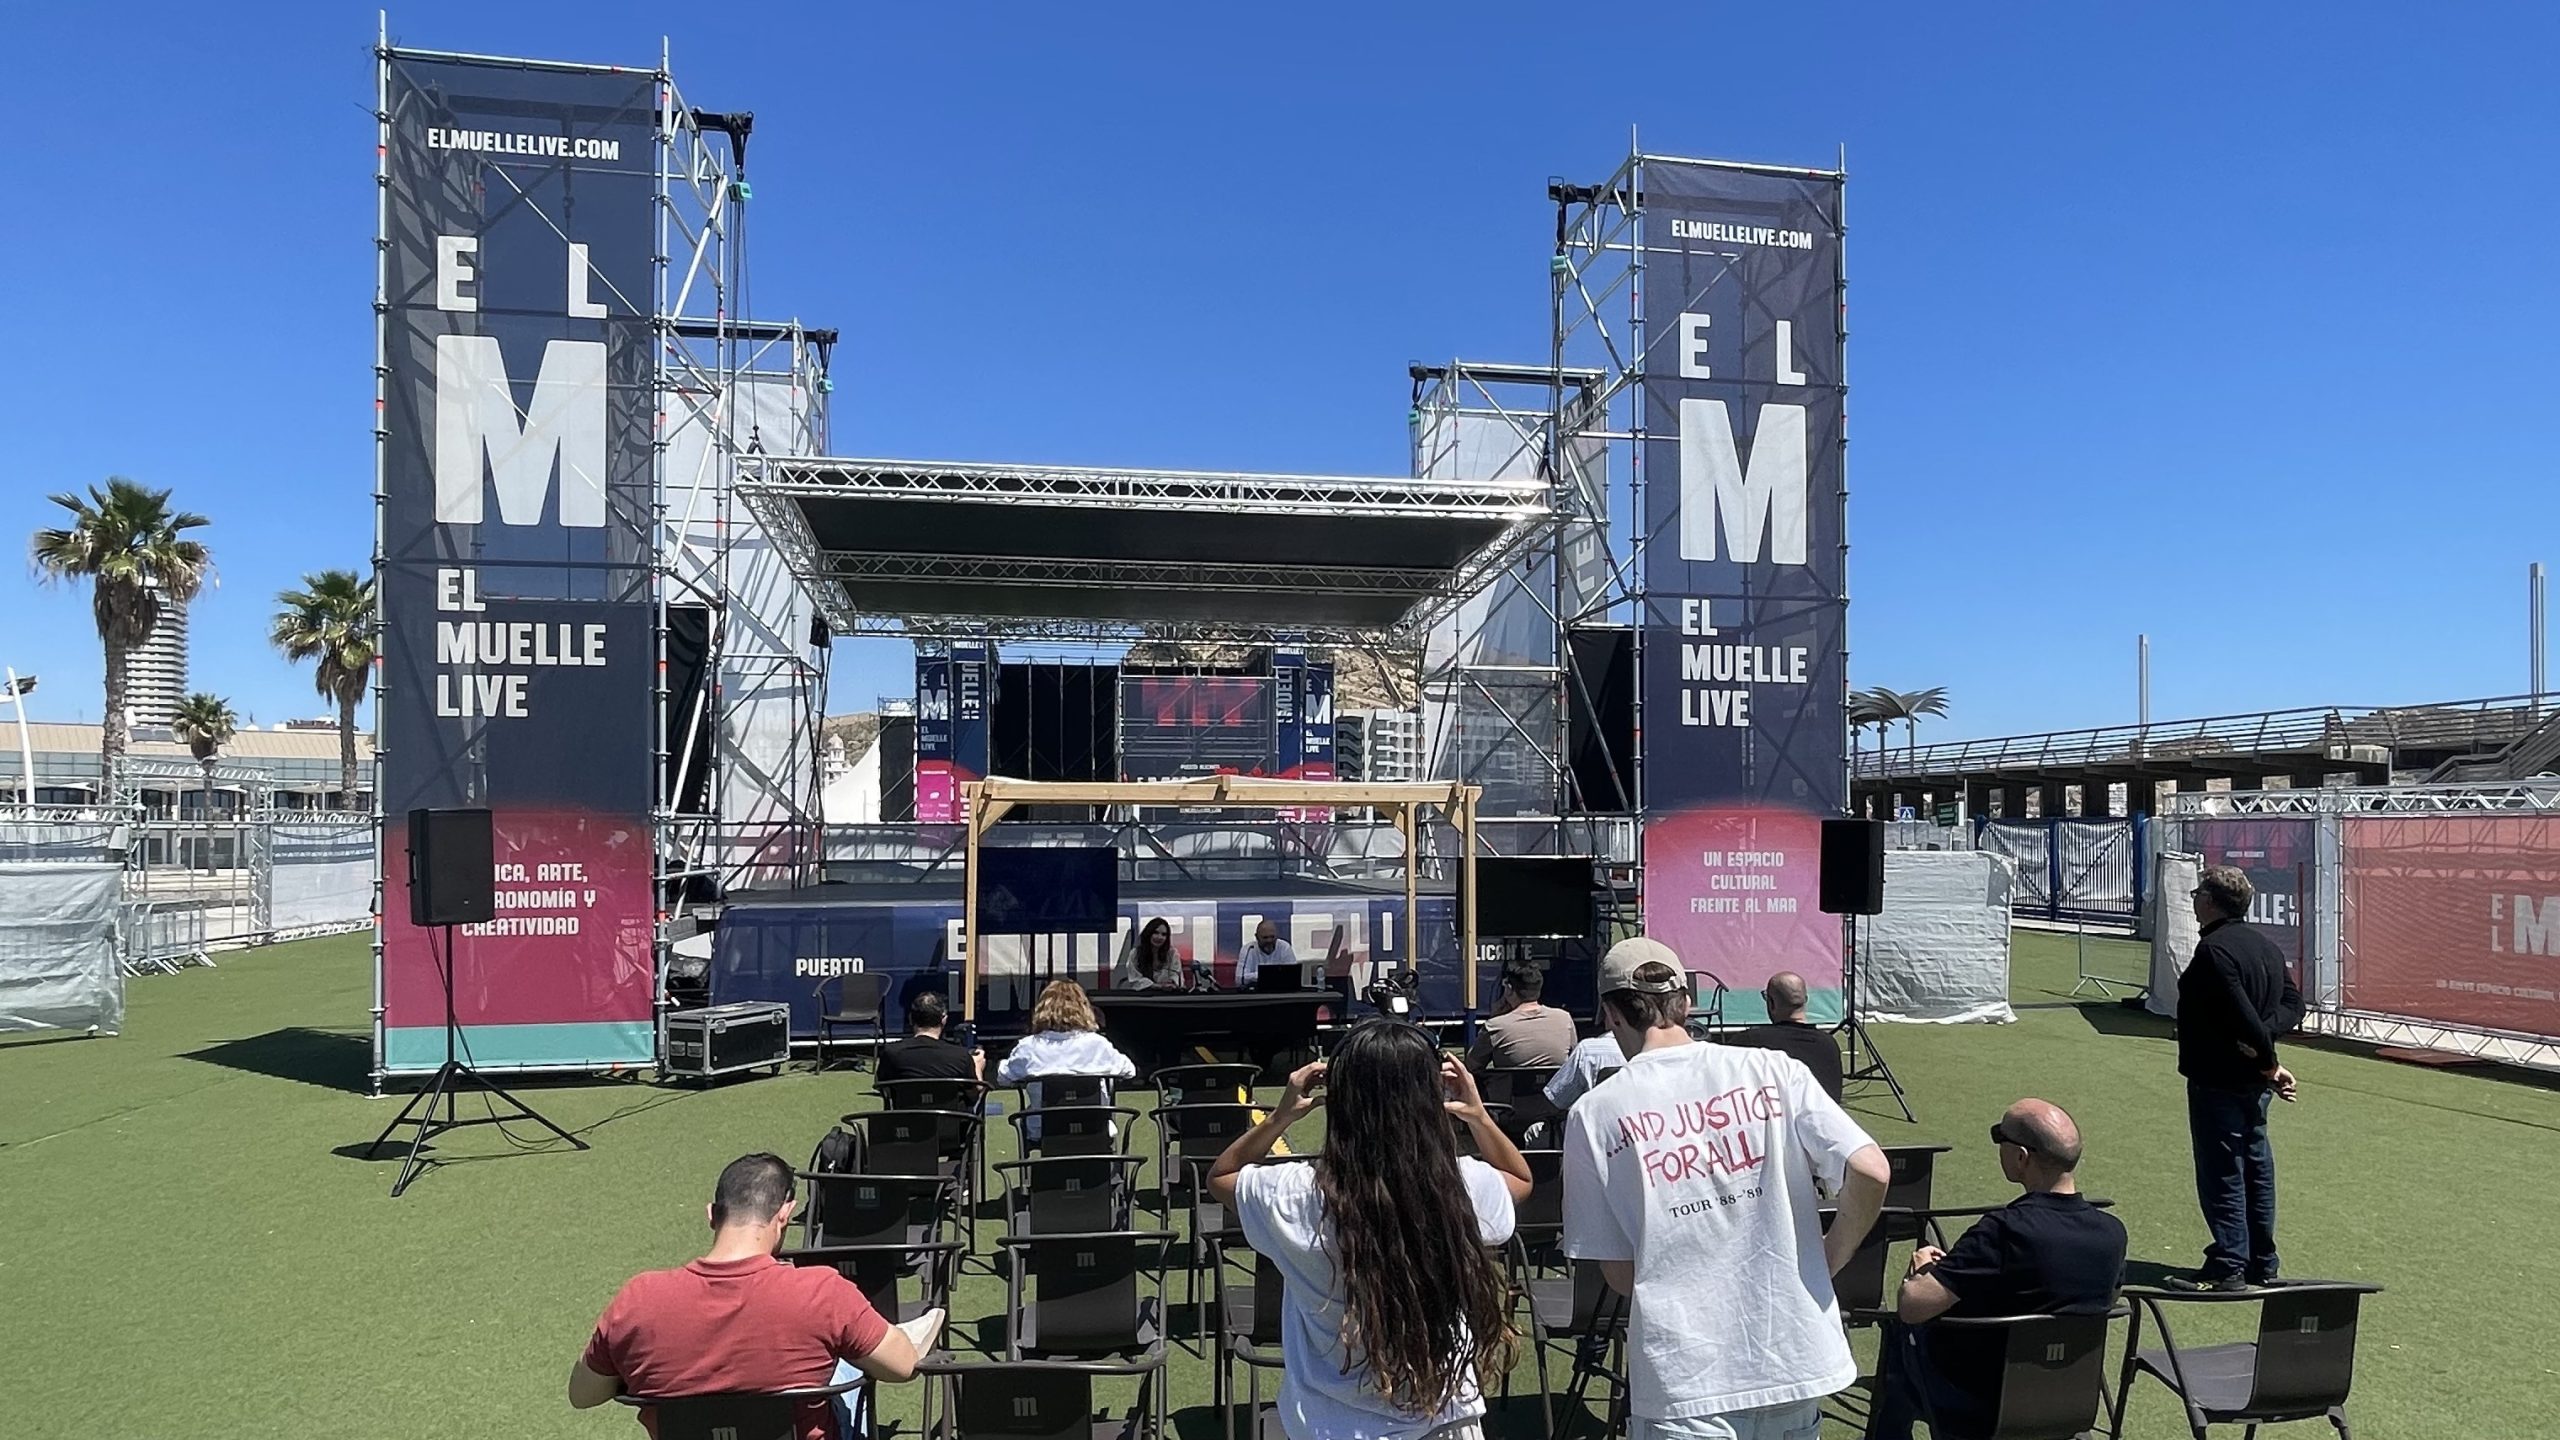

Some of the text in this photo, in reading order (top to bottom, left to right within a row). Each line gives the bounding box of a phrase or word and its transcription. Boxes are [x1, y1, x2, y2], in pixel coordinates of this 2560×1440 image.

[428, 128, 619, 160] ELMUELLELIVE.COM
[1672, 220, 1812, 250] ELMUELLELIVE.COM
[436, 335, 607, 527] M
[1679, 398, 1807, 565] M
[437, 568, 487, 611] EL
[1682, 598, 1718, 637] EL
[437, 621, 606, 666] MUELLE
[1682, 644, 1808, 684] MUELLE
[437, 674, 528, 717] LIVE
[920, 689, 948, 720] M
[1305, 694, 1331, 725] M
[1682, 689, 1750, 728] LIVE
[495, 863, 588, 883] ICA, ARTE,
[1703, 851, 1784, 867] UN ESPACIO
[494, 887, 596, 909] RONOMÍA Y
[1711, 875, 1777, 890] CULTURAL
[1691, 897, 1797, 913] FRENTE AL MAR
[461, 917, 580, 936] CREATIVIDAD
[796, 957, 864, 976] PUERTO
[1671, 1086, 1782, 1138] JUSTICE
[1643, 1130, 1766, 1188] FOR ALL
[1669, 1199, 1713, 1218] TOUR
